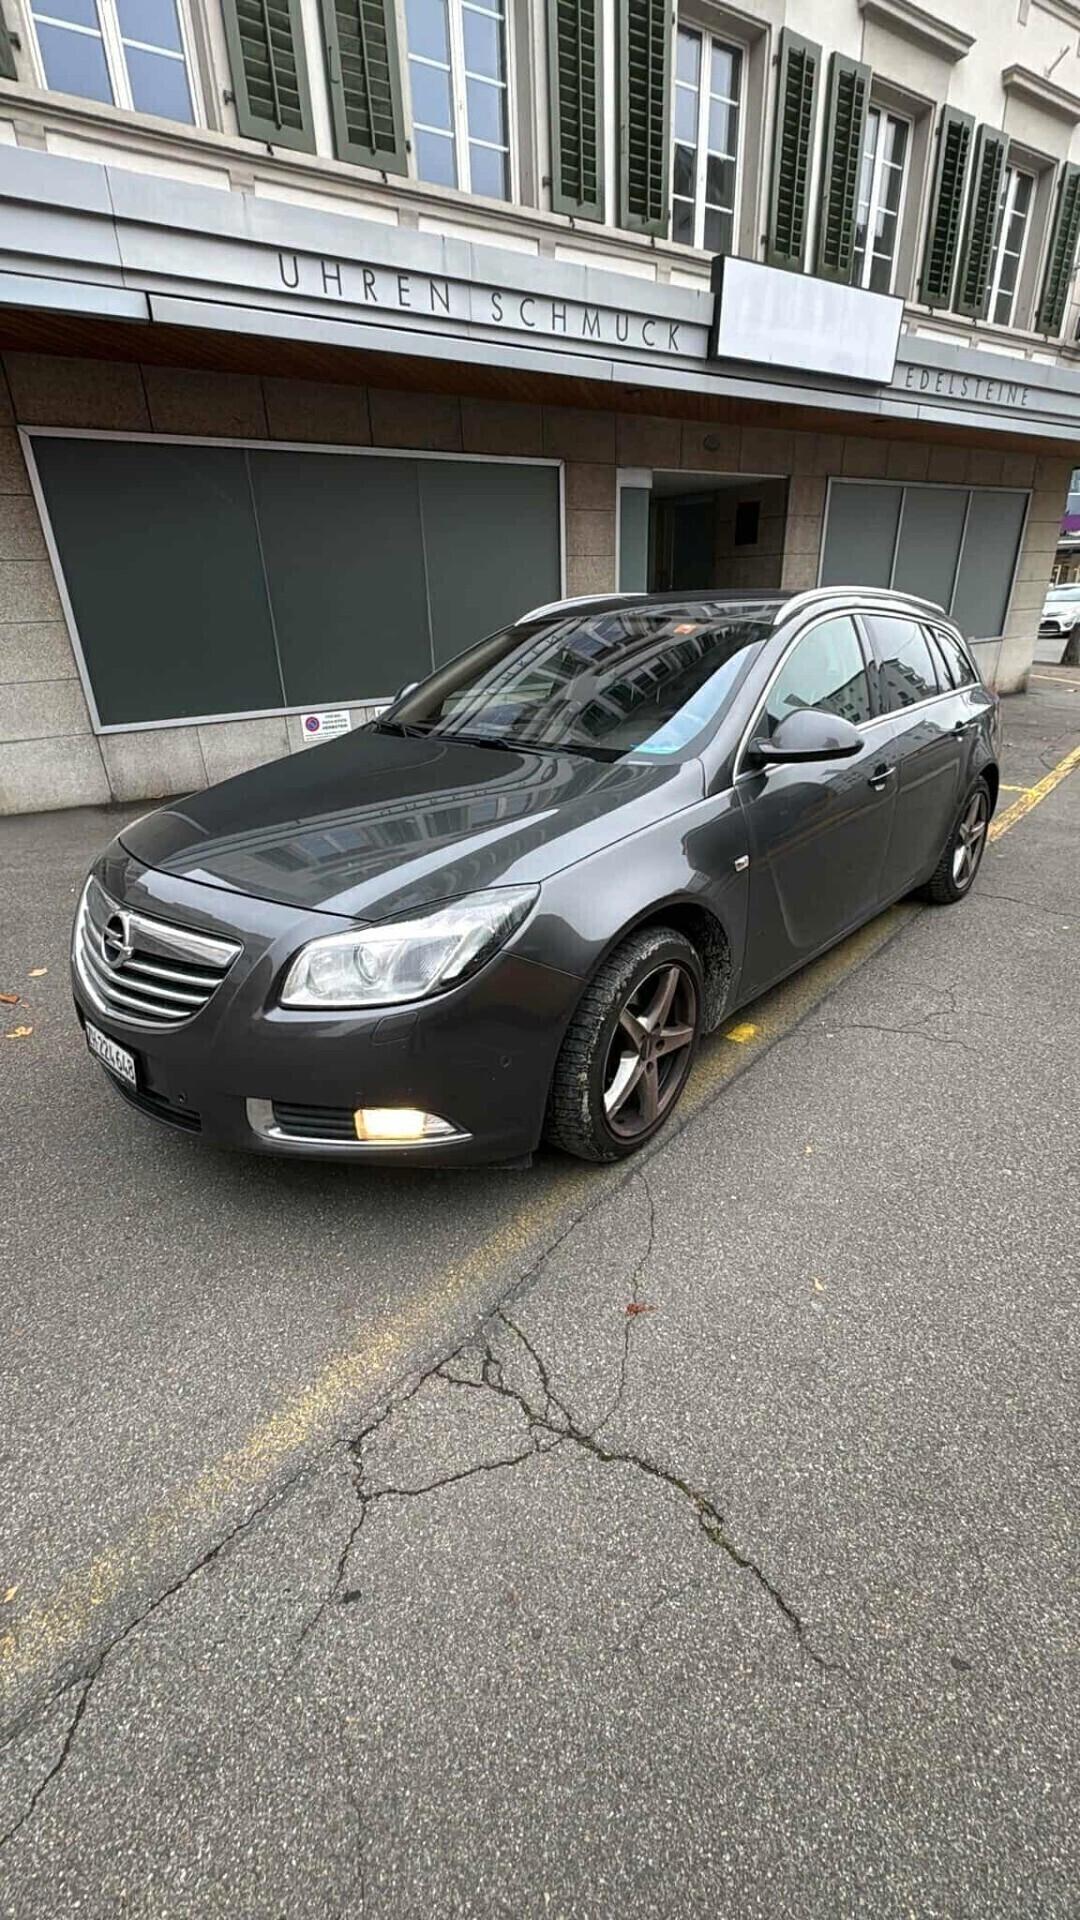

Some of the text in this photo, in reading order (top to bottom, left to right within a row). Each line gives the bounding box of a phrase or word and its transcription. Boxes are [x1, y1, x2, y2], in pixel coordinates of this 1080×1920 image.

[278, 253, 682, 351] UHREN SCHMUCK
[905, 367, 1028, 406] EDELSTEINE
